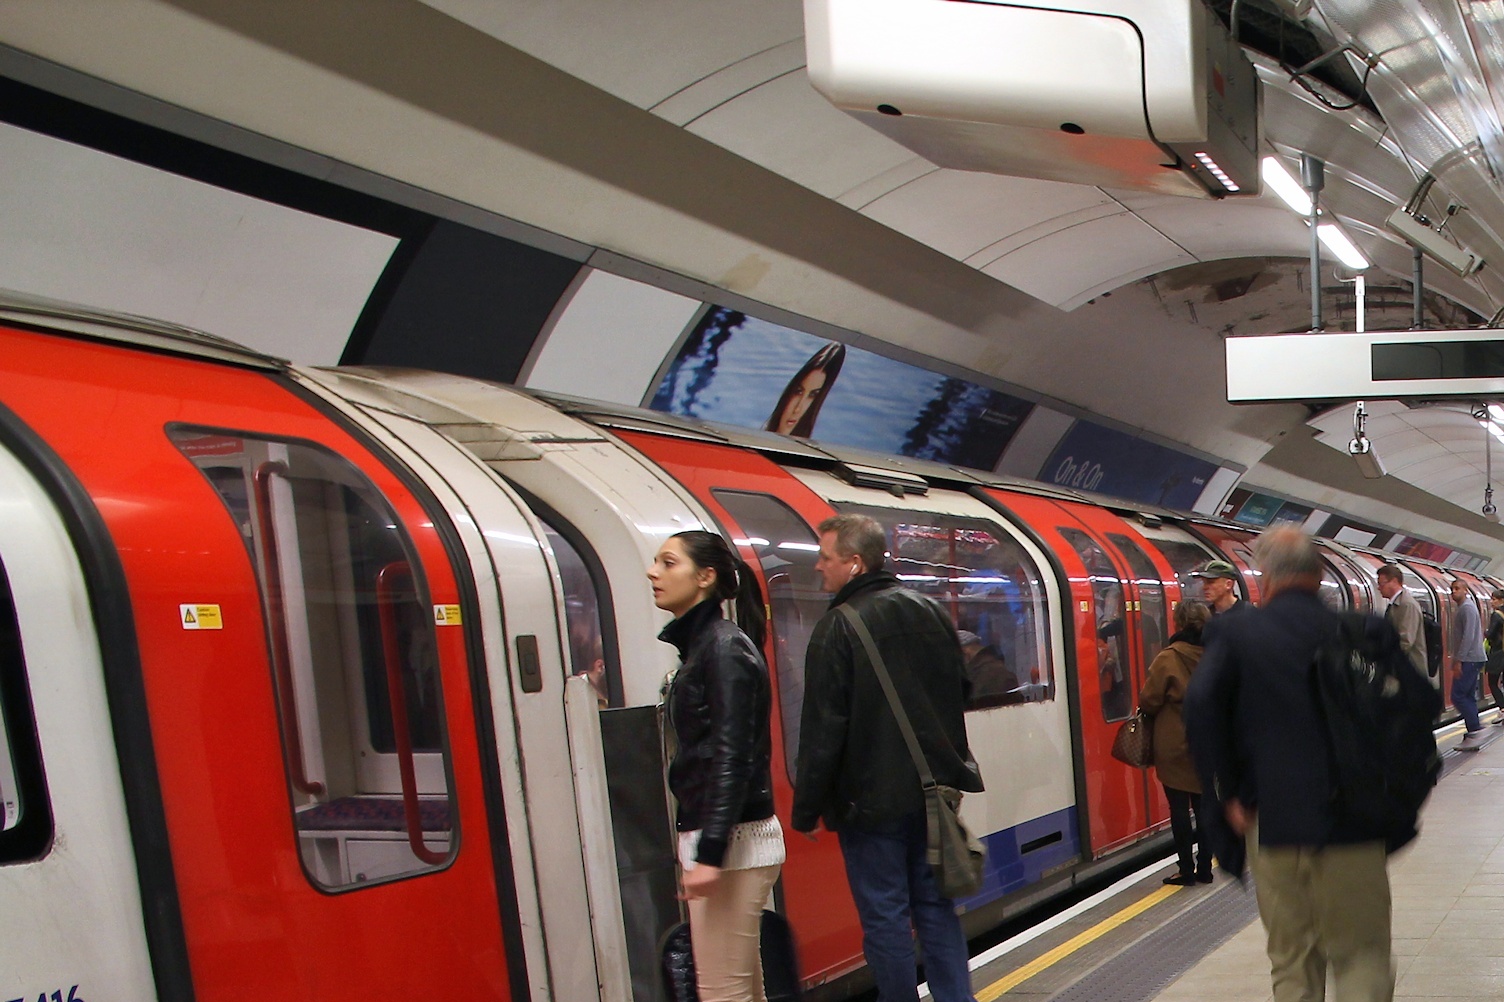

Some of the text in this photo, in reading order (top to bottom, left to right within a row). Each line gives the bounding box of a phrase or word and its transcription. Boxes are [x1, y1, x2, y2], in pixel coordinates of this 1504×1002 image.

[1054, 456, 1104, 491] On & On
